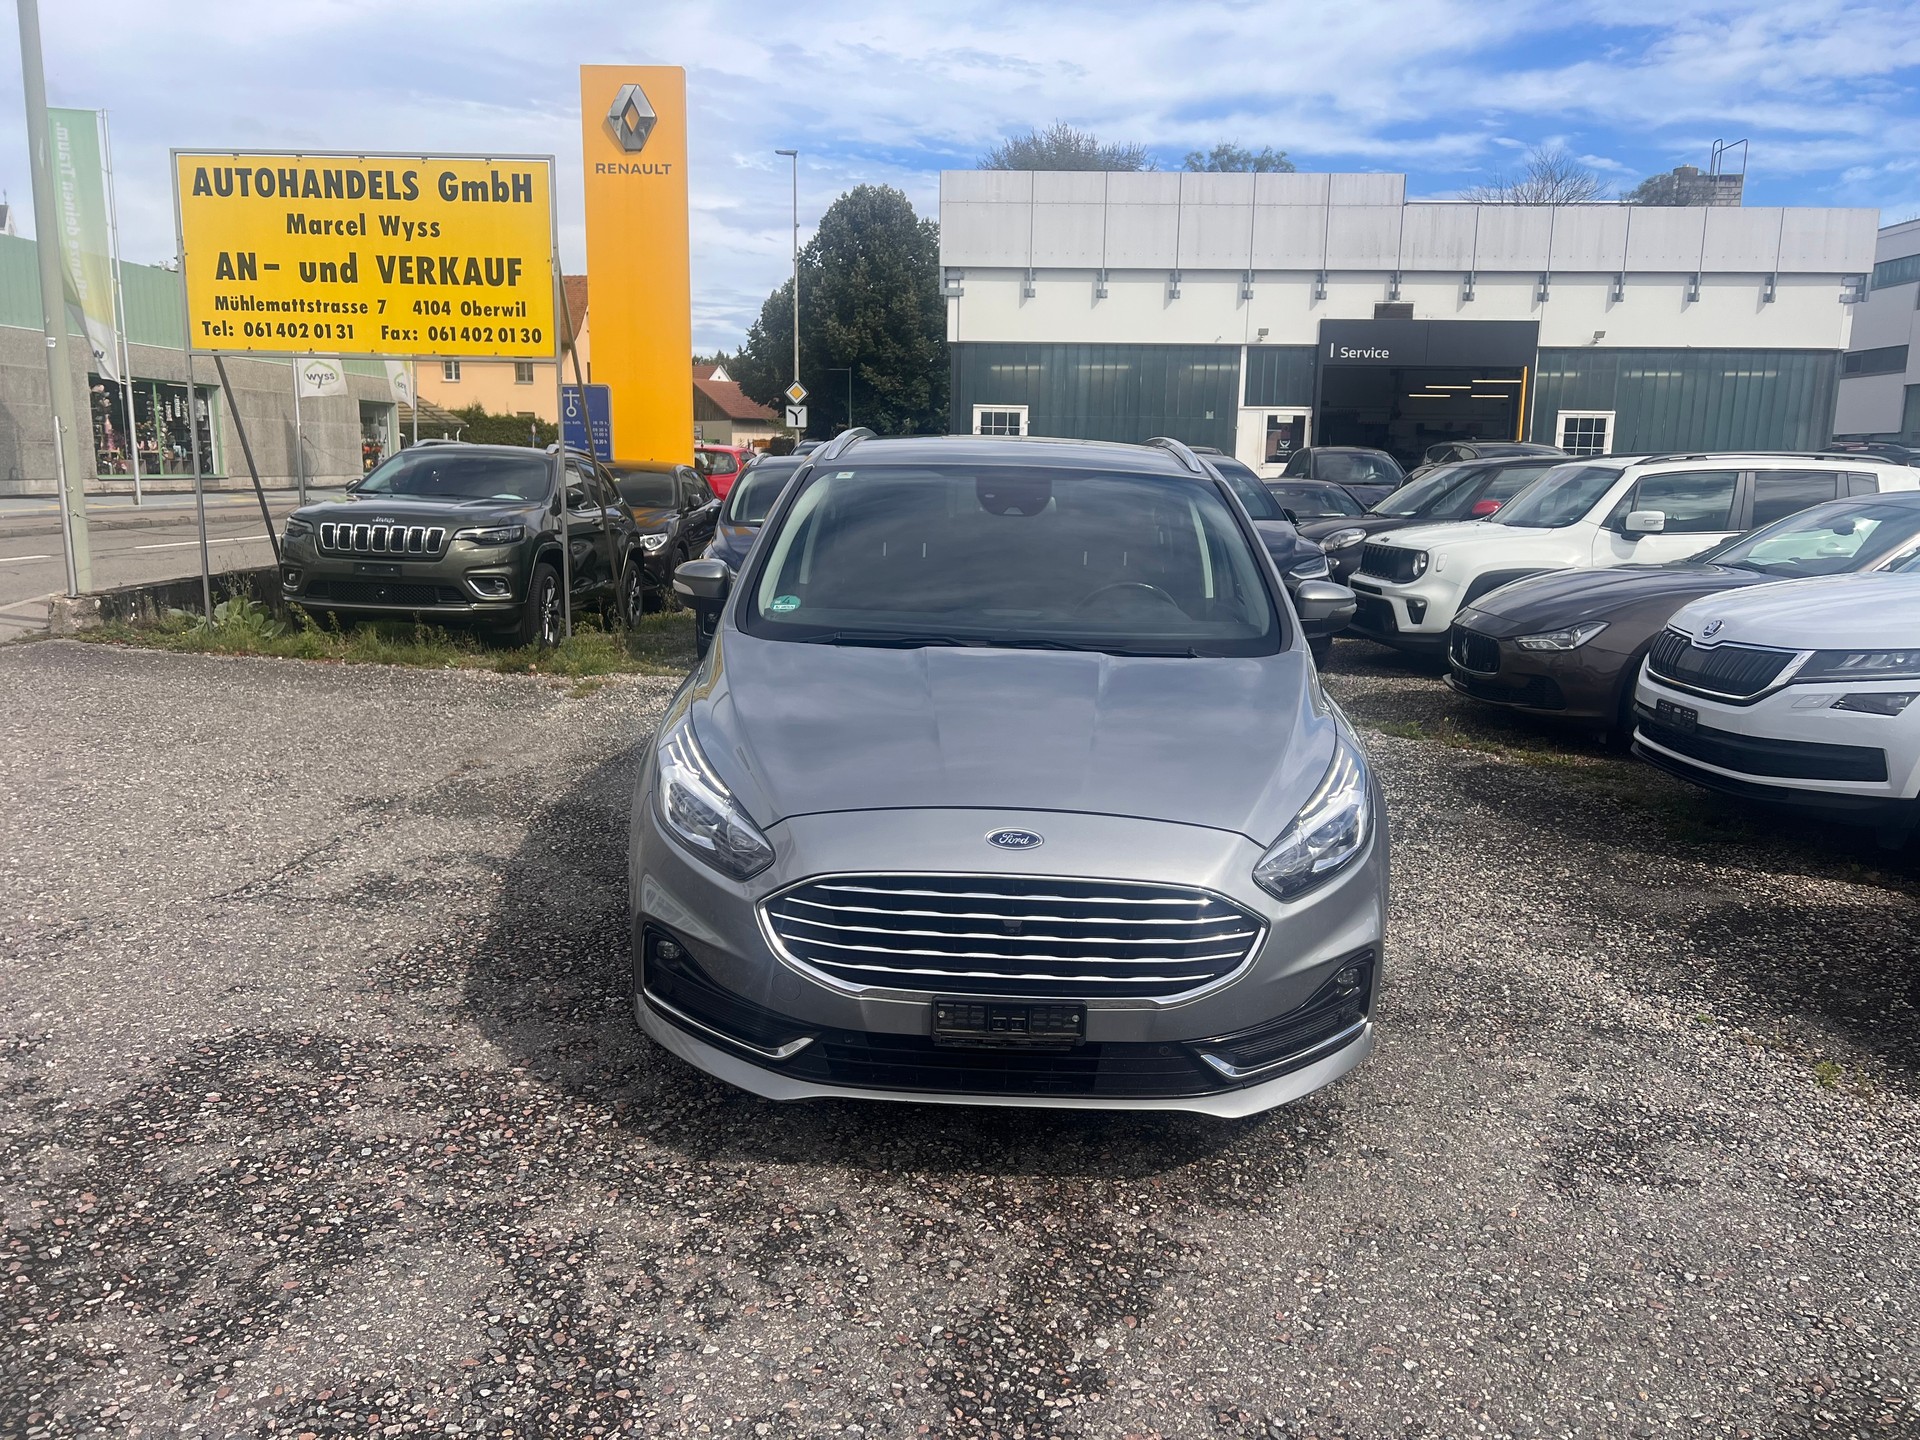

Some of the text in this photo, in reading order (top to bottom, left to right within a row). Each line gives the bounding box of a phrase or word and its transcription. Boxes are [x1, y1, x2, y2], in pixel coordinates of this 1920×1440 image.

[595, 163, 672, 175] RENAULT
[192, 167, 533, 203] AUTOHANDELS GmbH
[286, 213, 441, 242] Marcel Wyss
[299, 252, 359, 284] und
[375, 255, 522, 287] VERKAUF
[214, 294, 527, 317] Mühlemattstrasse 7 4104 Oberwil
[202, 319, 235, 337] Tel:
[381, 324, 419, 341] Fax:
[1340, 346, 1390, 359] Service
[305, 373, 335, 389] wyss
[999, 832, 1030, 845] Ford
